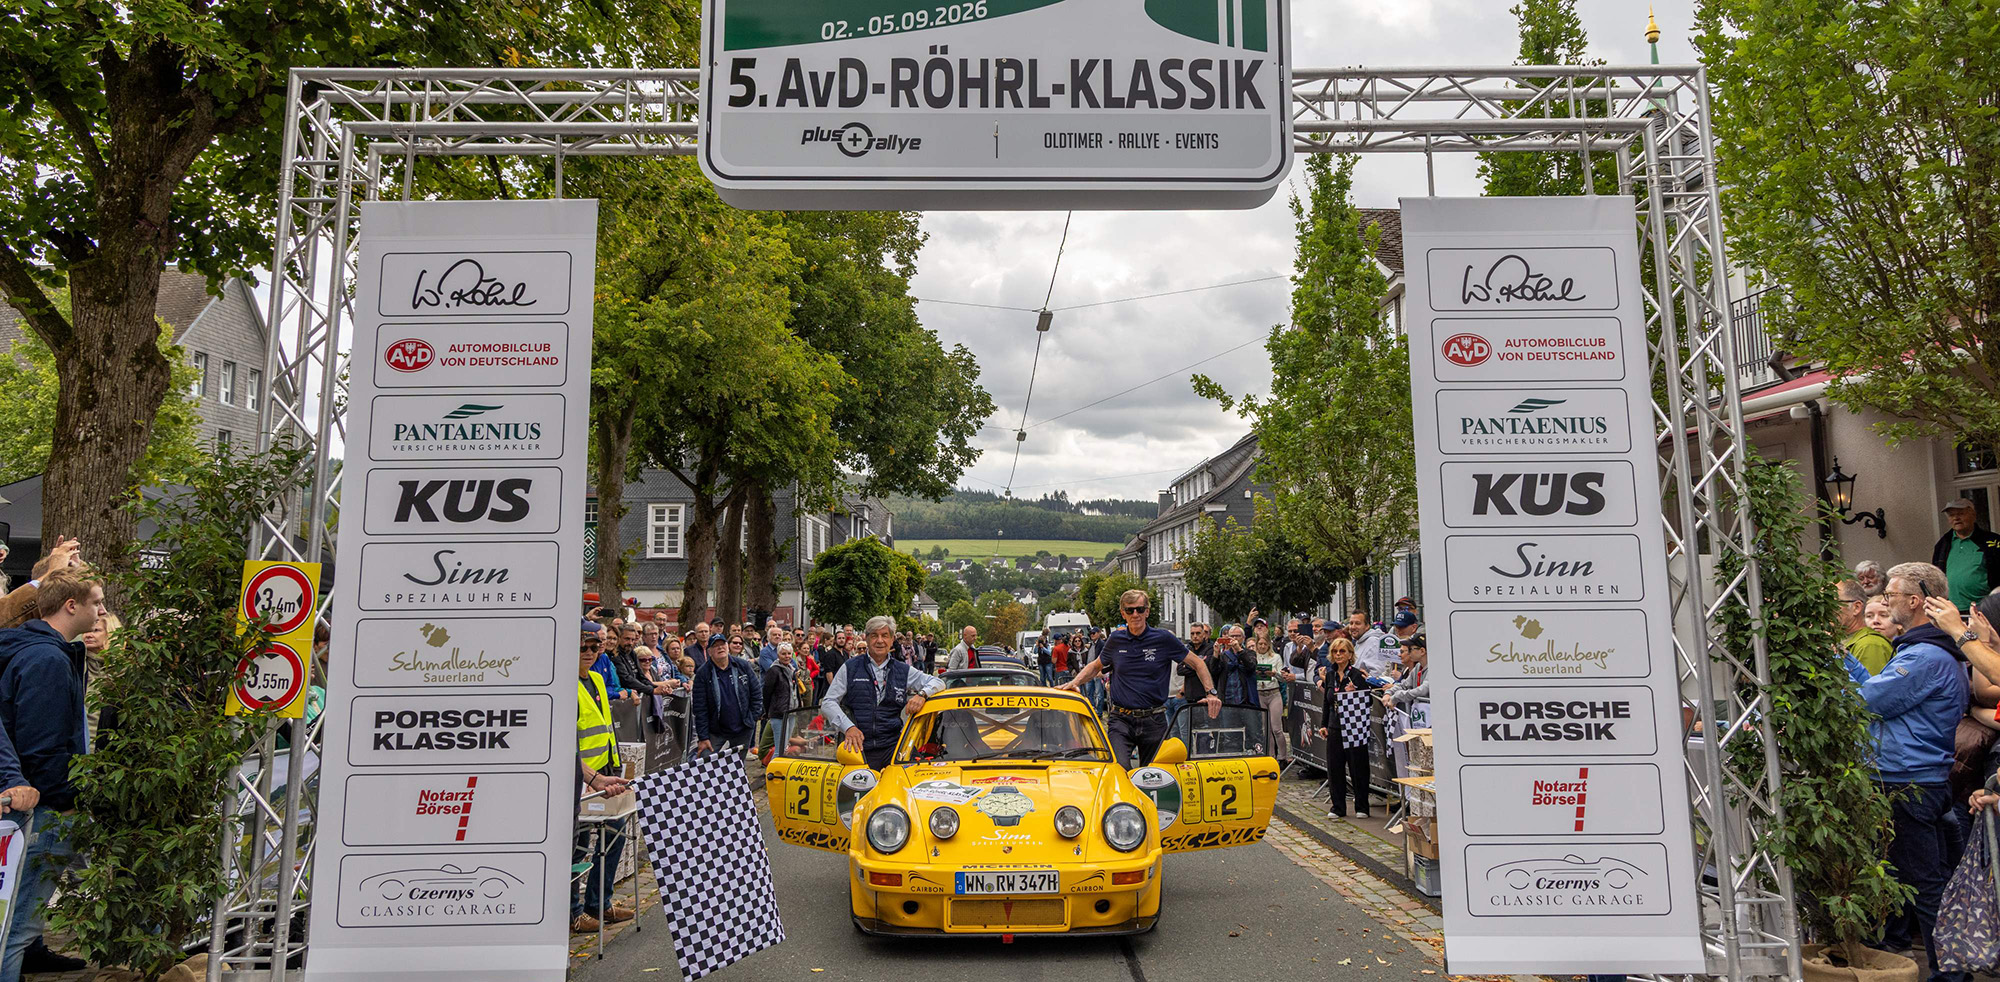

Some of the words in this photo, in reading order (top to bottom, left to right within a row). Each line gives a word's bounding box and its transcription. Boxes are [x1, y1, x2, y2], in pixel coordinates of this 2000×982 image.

[820, 20, 853, 41] 02.
[868, 0, 988, 36] 05.09.2026
[728, 57, 768, 107] 5.
[776, 44, 1269, 110] AvD-RÖHRL-KLASSIK
[1044, 132, 1103, 149] OLDTIMER
[1118, 132, 1160, 149] RALLYE
[1175, 132, 1219, 150] EVENTS
[448, 342, 551, 353] AUTOMOBILCLUB
[1504, 337, 1606, 348] AUTOMOBILCLUB
[439, 357, 466, 368] VON
[470, 356, 559, 367] DEUTSCHLAND
[1496, 351, 1524, 362] VON
[1526, 350, 1616, 361] DEUTSCHLAND
[392, 422, 541, 442] PANTAENIUS
[1460, 416, 1608, 435] PANTAENIUS
[392, 443, 540, 452] VERSICHERUNGSMAKLER
[1461, 437, 1609, 445] VERSICHERUNGSMAKLER
[394, 477, 533, 523] KÜS
[1471, 471, 1606, 517] KÜS
[1488, 542, 1595, 579] Sinn
[403, 549, 510, 587] Sinn
[1473, 584, 1620, 596] SPEZIALUHREN
[384, 592, 532, 604] SPEZIALUHREN
[1522, 663, 1582, 675] Sauerland
[423, 671, 484, 683] Sauerland
[957, 697, 994, 708] MAC
[996, 696, 1051, 708] JEANS
[1479, 700, 1631, 720] PORSCHE
[374, 709, 528, 729] PORSCHE
[1480, 722, 1618, 741] KLASSIK
[372, 731, 511, 751] KLASSIK
[1532, 780, 1588, 792] Notarzt
[417, 789, 475, 801] Notarzt
[789, 801, 796, 814] H
[797, 784, 810, 816] 2
[1210, 804, 1218, 817] H
[1220, 783, 1238, 817] 2
[1532, 793, 1576, 806] Börse
[416, 802, 461, 815] Börse
[981, 829, 1031, 841] Sinn
[1160, 829, 1196, 850] ssic
[1197, 823, 1267, 847] Powe
[910, 885, 945, 893] CAIRBON
[965, 875, 985, 892] WN
[996, 875, 1015, 892] RW
[1019, 874, 1057, 891] 347H
[1070, 885, 1104, 893] CAIRBON
[1535, 876, 1601, 892] Czernys
[408, 886, 475, 902] Czernys
[1490, 894, 1563, 907] CLASSIC
[1571, 893, 1645, 906] GARAGE
[360, 905, 435, 917] CLASSIC
[443, 903, 517, 916] GARAGE
